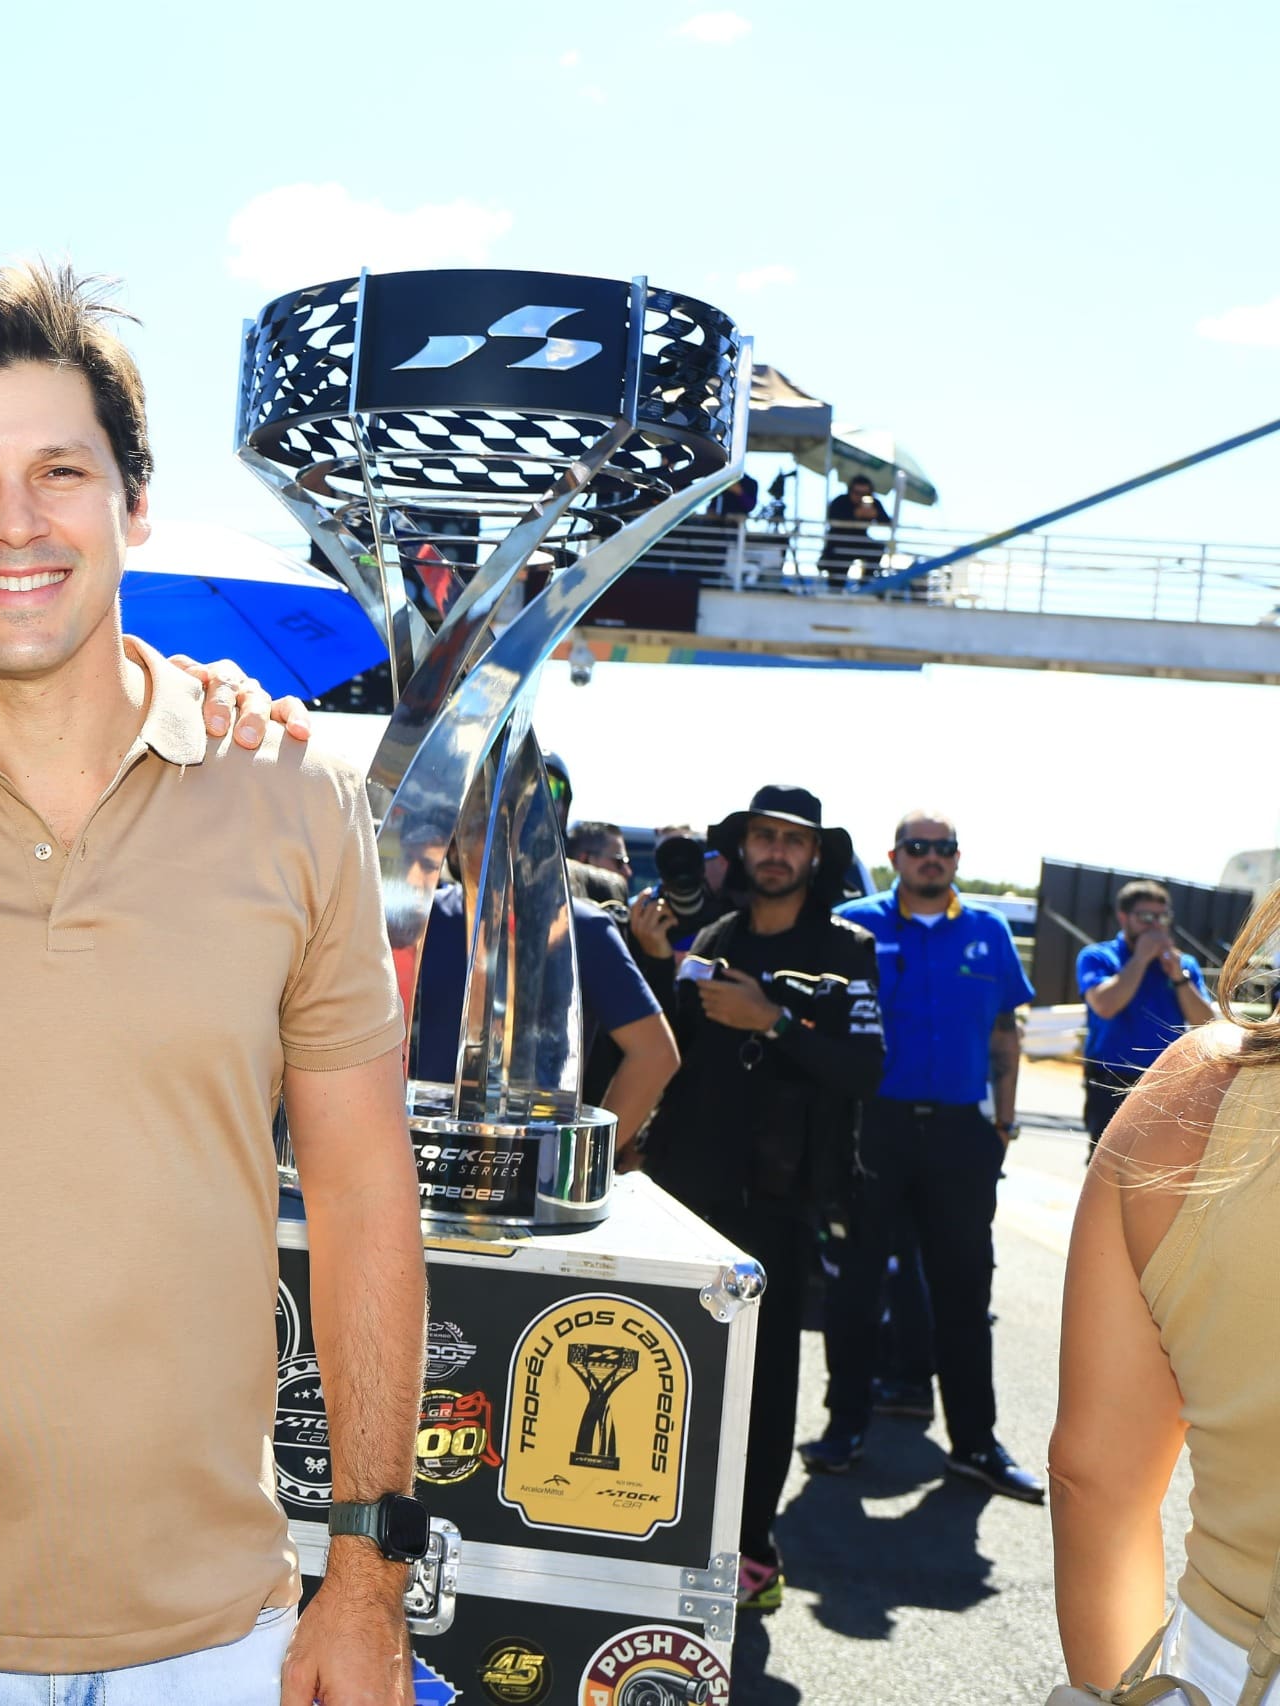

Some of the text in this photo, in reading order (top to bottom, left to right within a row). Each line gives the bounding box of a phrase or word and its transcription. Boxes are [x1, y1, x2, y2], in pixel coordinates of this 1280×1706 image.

[460, 1164, 518, 1178] SERIES
[554, 1310, 615, 1339] DOS
[485, 1654, 545, 1685] 45
[596, 1633, 673, 1679] PUSH
